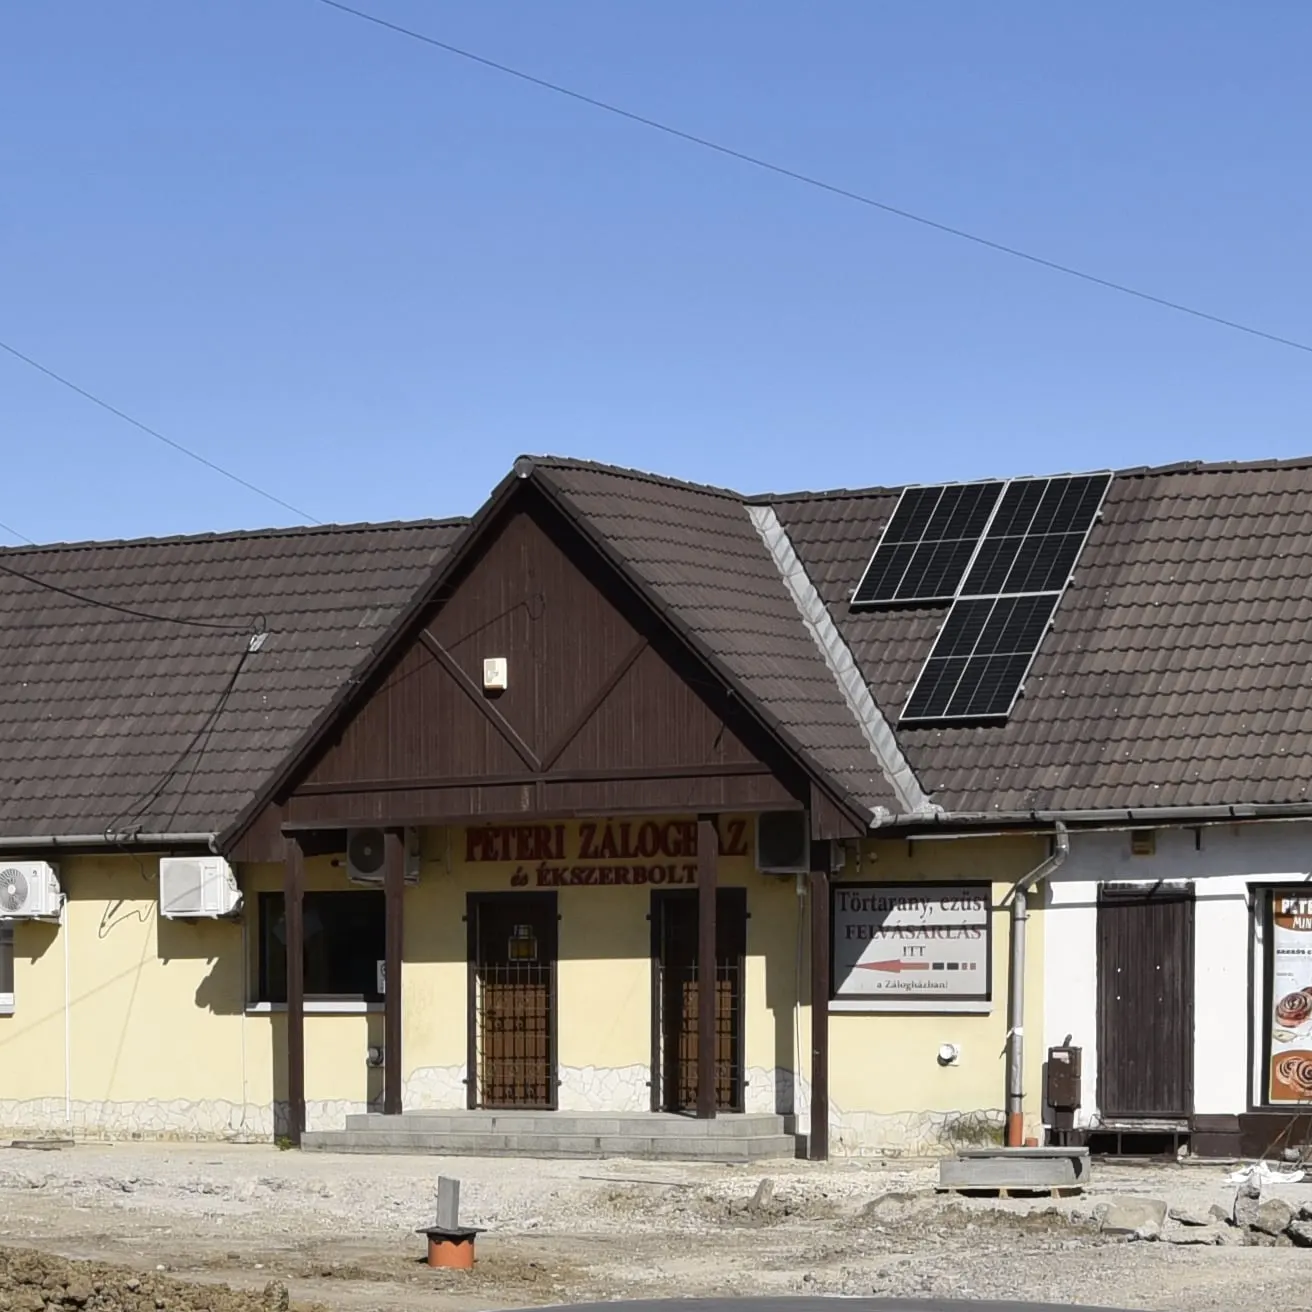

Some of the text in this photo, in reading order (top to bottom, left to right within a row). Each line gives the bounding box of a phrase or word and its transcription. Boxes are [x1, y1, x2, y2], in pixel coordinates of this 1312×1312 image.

[465, 817, 748, 862] PÉTERI ZÁLOGHZ
[510, 862, 698, 888] és ÉKSZERBOLT
[845, 920, 982, 940] FELVÁSÁRLÁS
[902, 945, 926, 957] ITT
